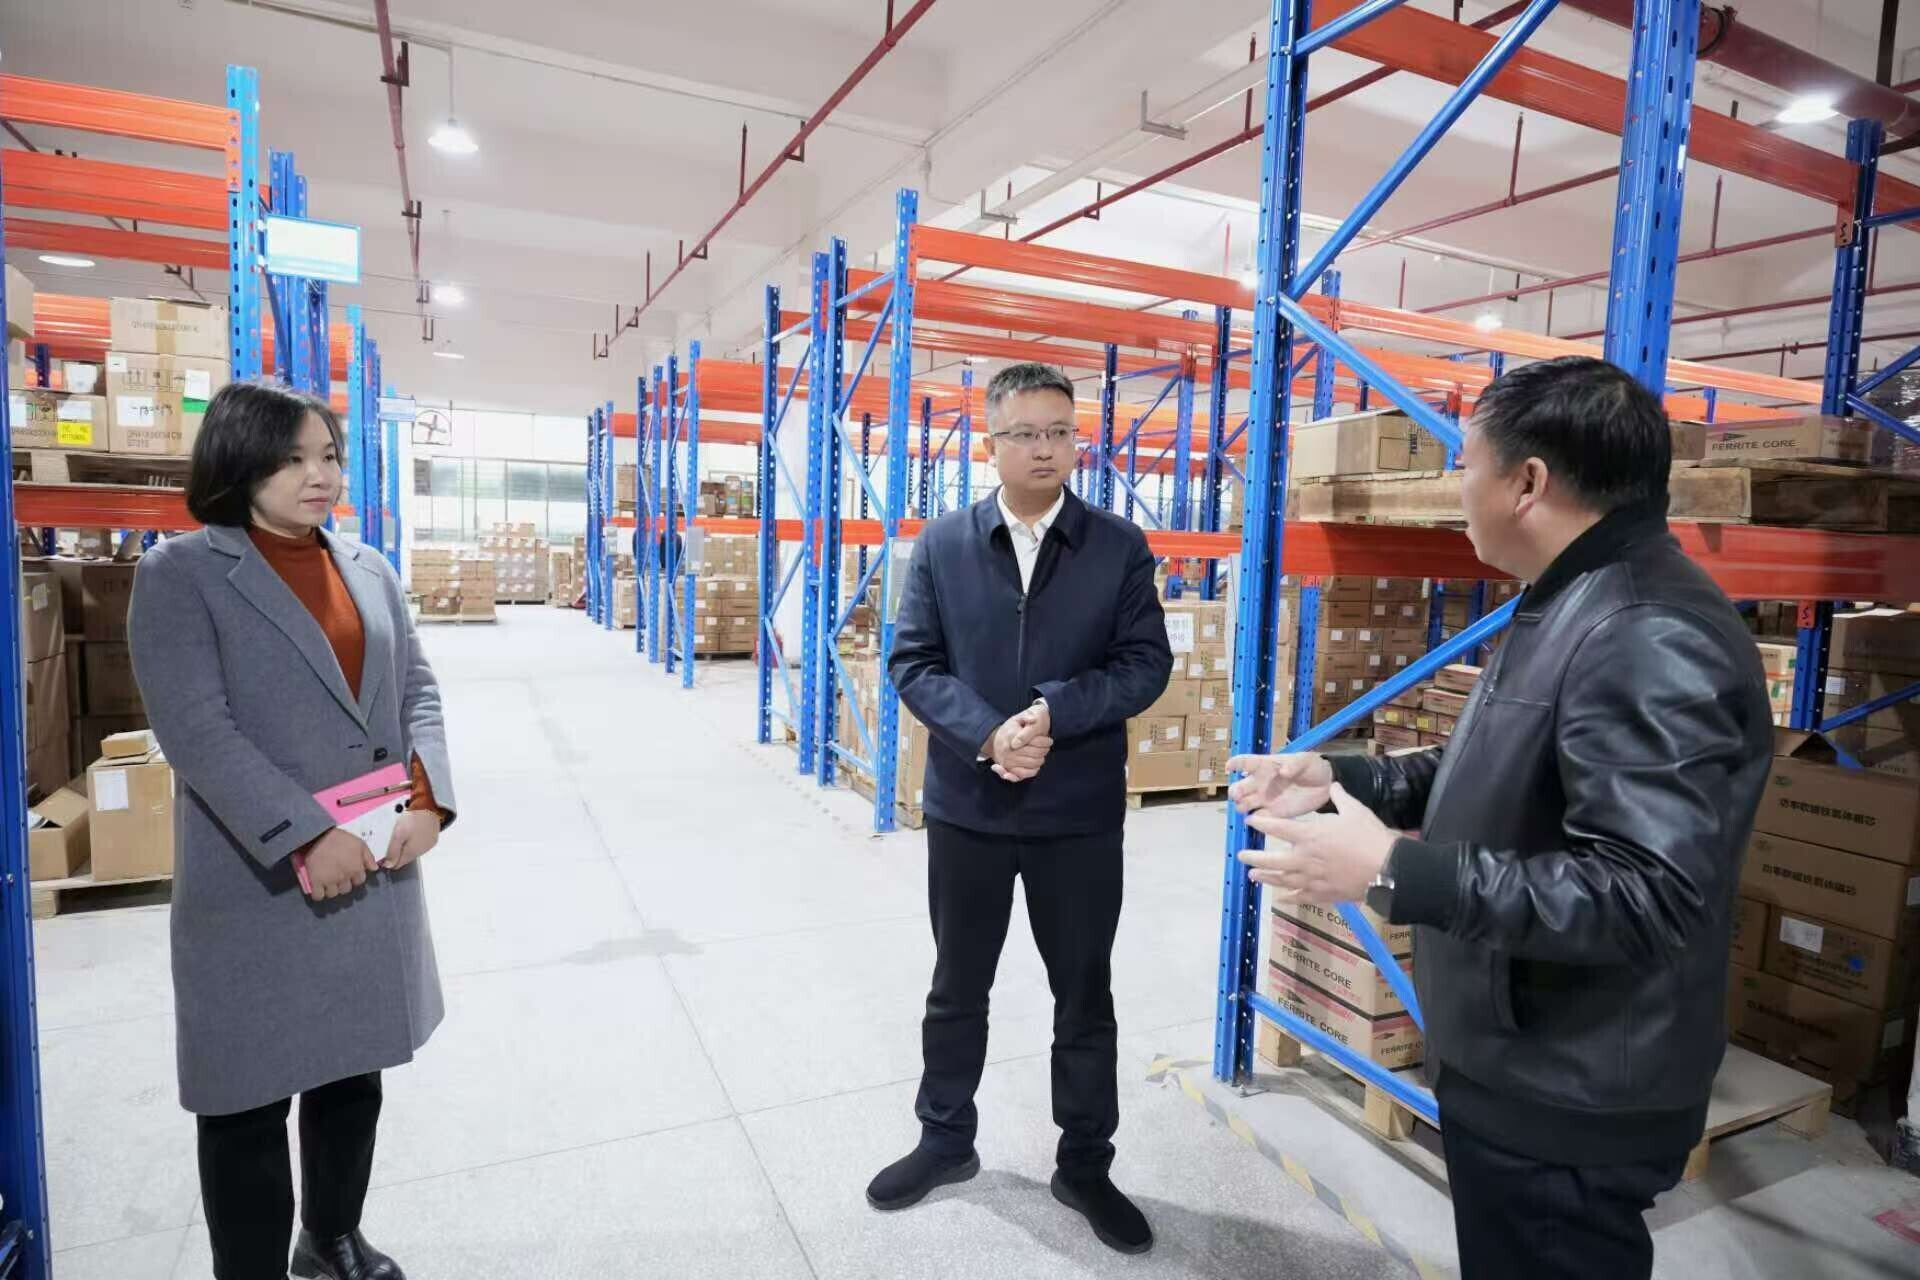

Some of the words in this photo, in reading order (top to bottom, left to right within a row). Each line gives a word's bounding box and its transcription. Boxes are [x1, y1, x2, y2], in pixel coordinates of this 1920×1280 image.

[1712, 440, 1759, 451] FERRITE
[1762, 439, 1797, 449] CORE
[1327, 912, 1350, 930] COR
[1281, 944, 1321, 973] FERRITE
[1323, 967, 1352, 990] CORE
[1320, 1022, 1349, 1045] CORE
